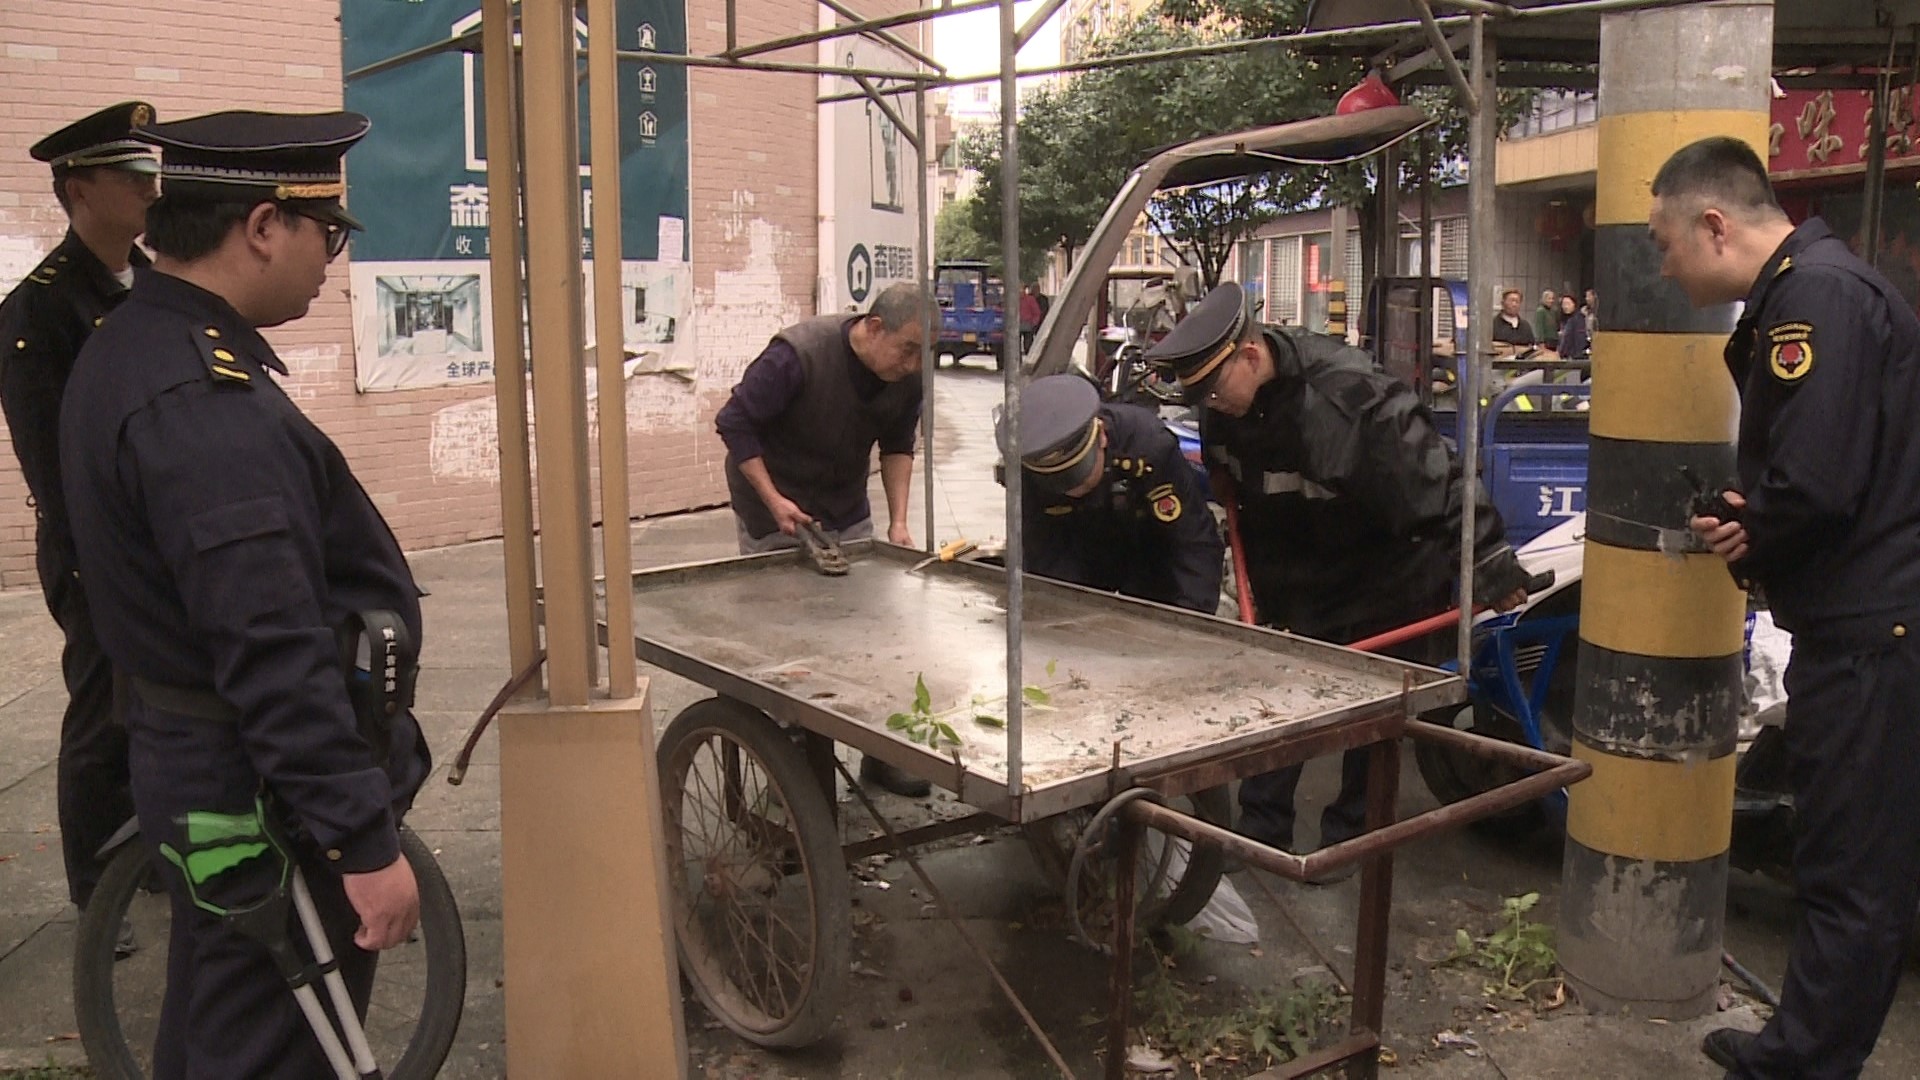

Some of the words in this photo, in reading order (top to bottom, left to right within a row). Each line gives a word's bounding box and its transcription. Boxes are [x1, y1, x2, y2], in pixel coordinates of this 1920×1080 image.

[446, 361, 496, 378] 全球产
[1537, 485, 1583, 516] 江
